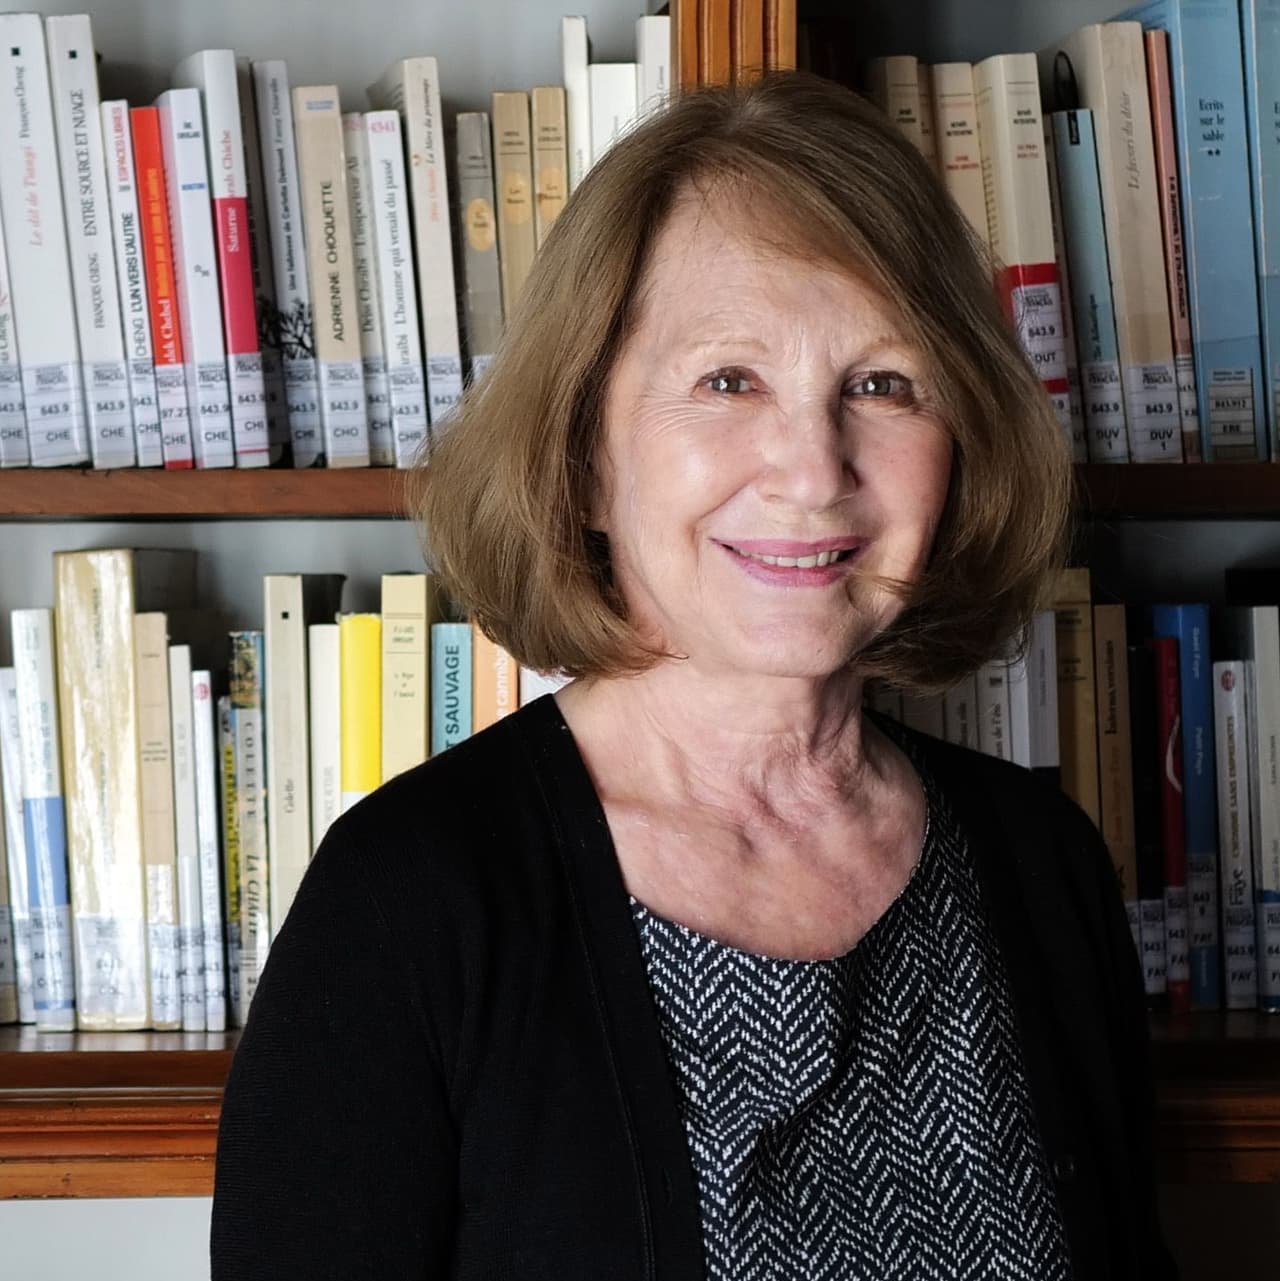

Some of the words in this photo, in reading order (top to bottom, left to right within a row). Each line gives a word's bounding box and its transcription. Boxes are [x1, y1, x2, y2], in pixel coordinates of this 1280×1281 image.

[72, 88, 85, 128] NUAGE
[76, 130, 89, 145] ET
[77, 148, 93, 194] SOURCE
[382, 159, 399, 190] passé
[82, 198, 97, 237] ENTRE
[384, 192, 396, 208] du
[121, 212, 137, 255] L'AUTRE
[226, 207, 239, 252] Saturne
[320, 180, 338, 264] CHOQUETTE
[384, 210, 400, 245] venait
[126, 257, 140, 286] VERS
[387, 248, 403, 267] qui
[128, 287, 143, 312] L'UN
[328, 271, 344, 341] ADRIENNE
[388, 270, 407, 325] L'homme
[132, 318, 146, 356] CHENG
[1028, 327, 1056, 337] 843.9
[445, 644, 459, 736] SAUVAGE
